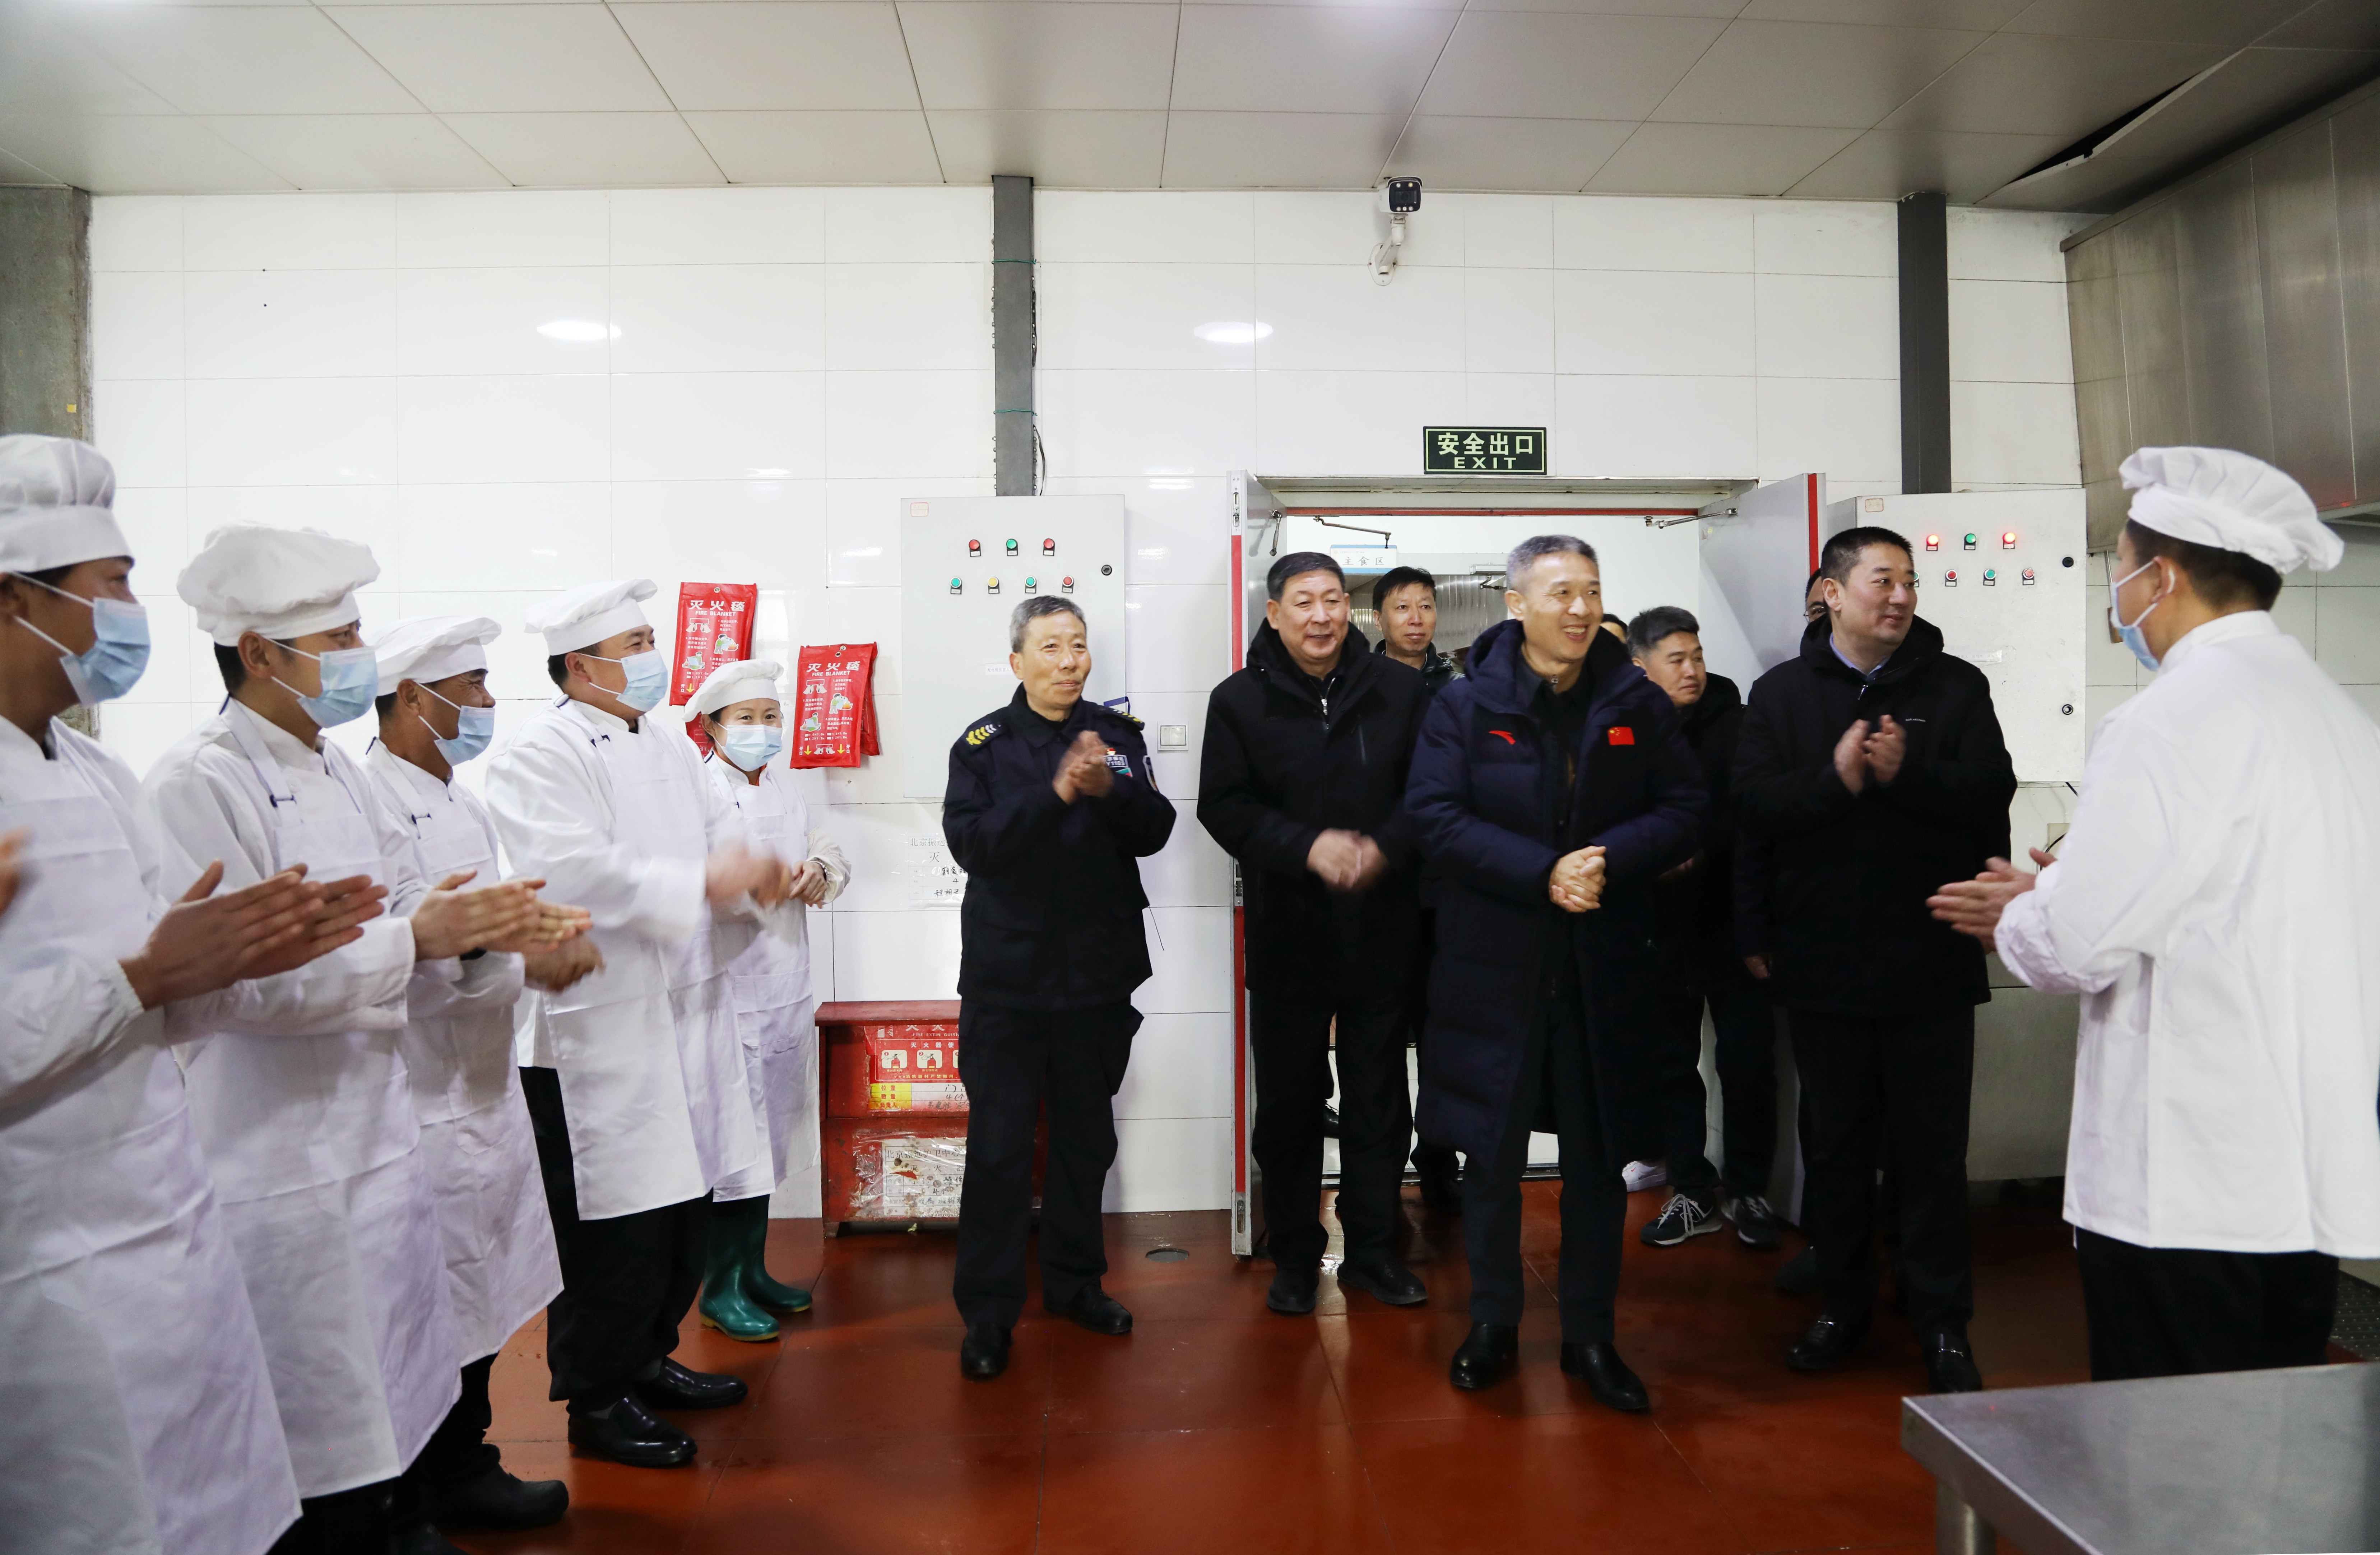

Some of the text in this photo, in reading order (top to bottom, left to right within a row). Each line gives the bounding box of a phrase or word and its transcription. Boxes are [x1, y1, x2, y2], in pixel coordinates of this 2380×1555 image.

[1438, 432, 1533, 455] 安全出口
[1454, 457, 1516, 469] EXIT
[1342, 556, 1384, 566] 主食区
[689, 600, 745, 612] 灭火毯
[806, 661, 860, 672] 灭火毯
[680, 683, 685, 693] 开口
[799, 746, 803, 755] 开口
[846, 744, 850, 753] 开口
[910, 837, 948, 847] 北京振远
[929, 851, 940, 863] 灭
